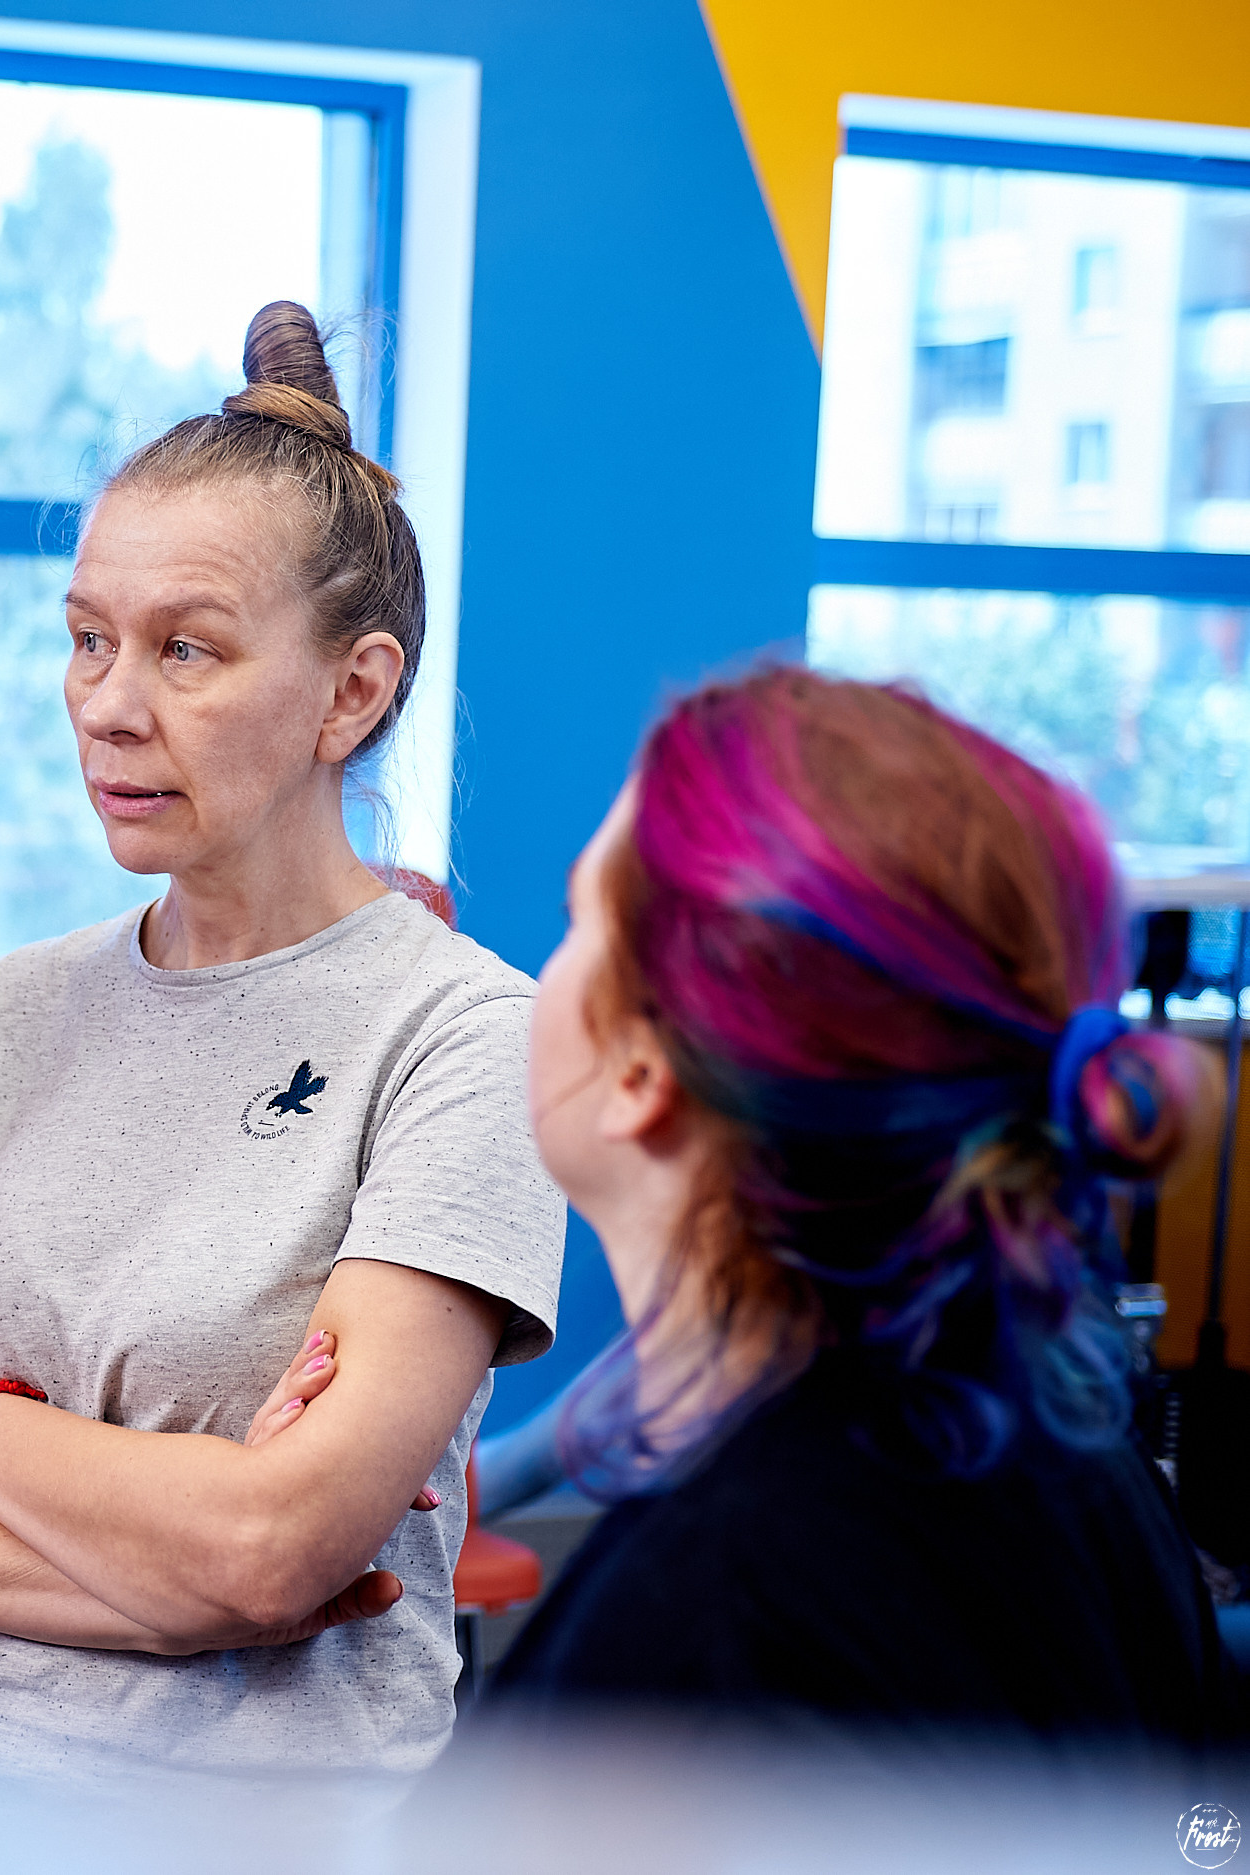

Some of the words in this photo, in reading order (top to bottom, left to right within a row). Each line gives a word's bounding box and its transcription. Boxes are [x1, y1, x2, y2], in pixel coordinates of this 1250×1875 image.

[240, 1101, 254, 1121] SPIRIT
[252, 1083, 279, 1101] BELONG
[251, 1131, 260, 1140] TO
[260, 1132, 276, 1140] WILD
[276, 1125, 290, 1137] LIFE
